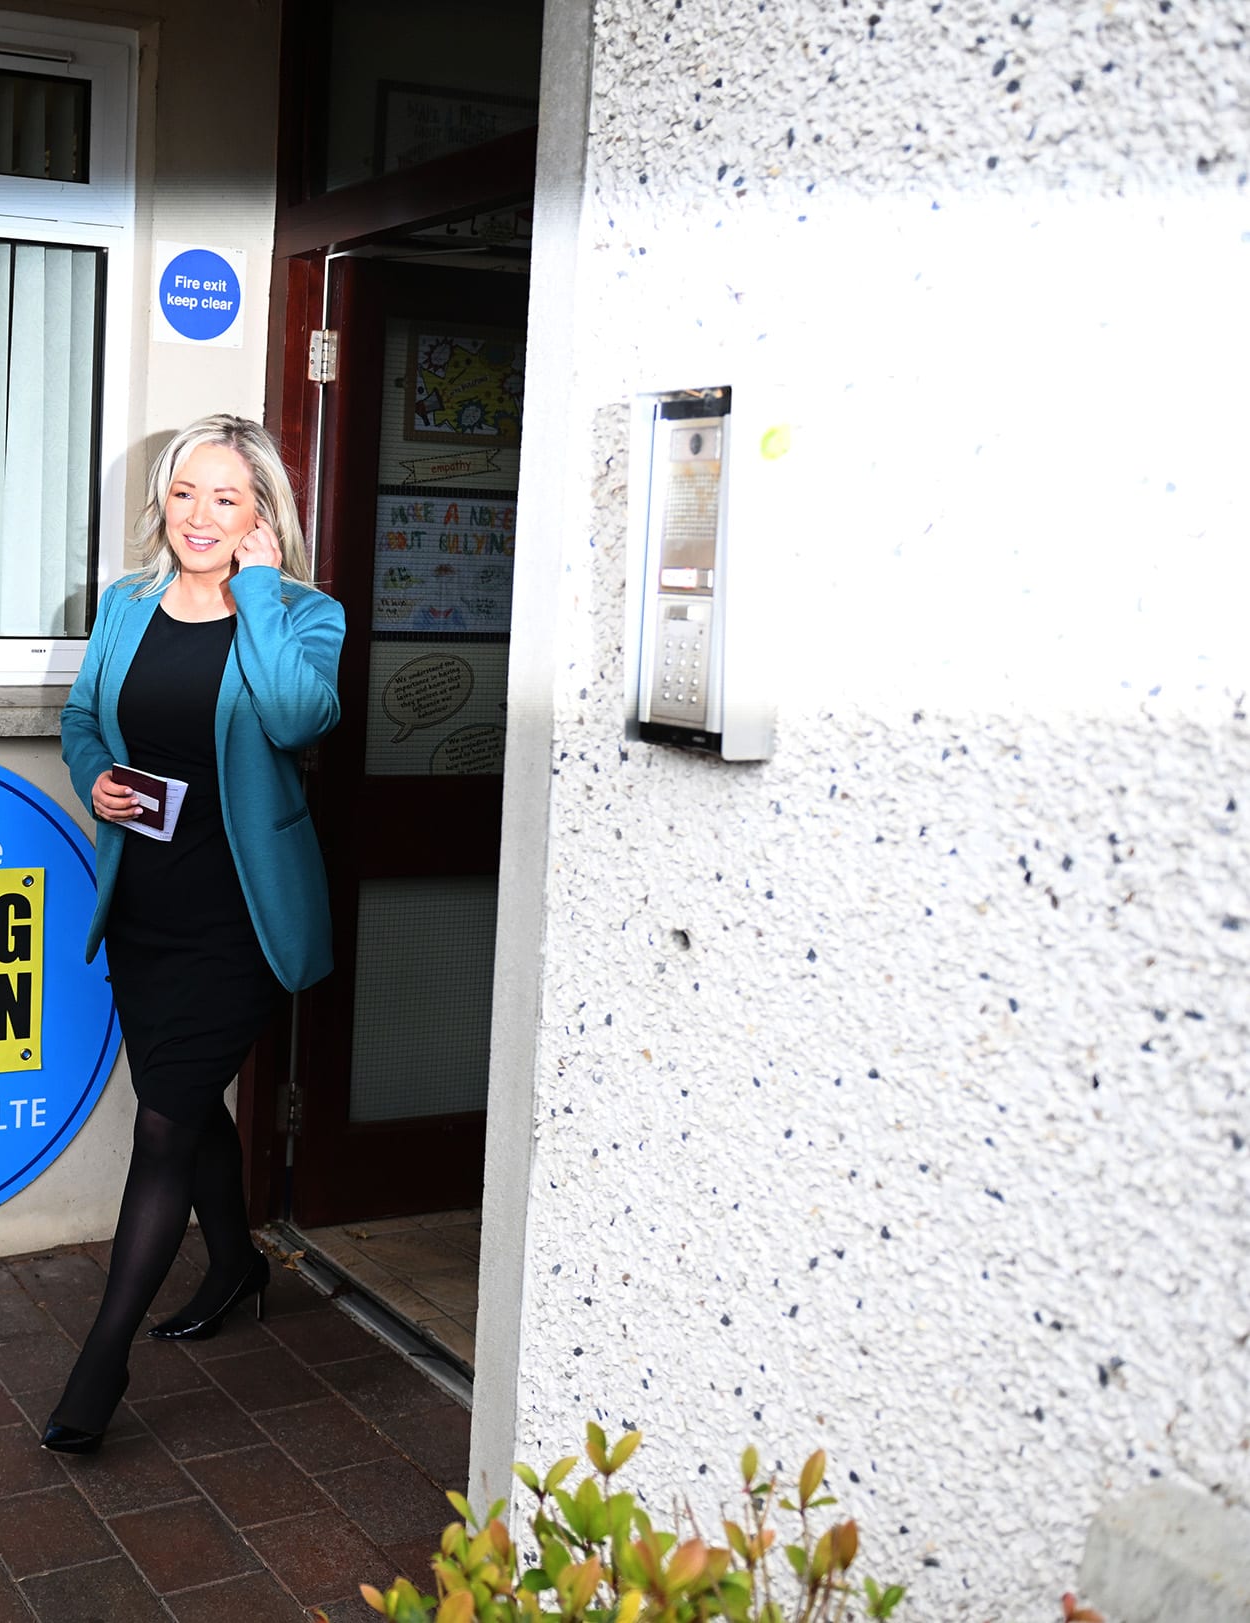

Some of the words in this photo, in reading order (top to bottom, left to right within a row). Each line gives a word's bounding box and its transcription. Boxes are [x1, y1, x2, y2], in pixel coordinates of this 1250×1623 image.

[175, 275, 200, 290] Fire
[203, 280, 227, 292] exit
[167, 292, 198, 310] keep
[201, 296, 233, 311] clear
[430, 460, 471, 474] empathy
[390, 501, 435, 525] MAKE
[444, 502, 459, 525] A
[470, 505, 514, 531] NOISE
[378, 531, 426, 552] ABOUT
[439, 532, 514, 556] BULLYING
